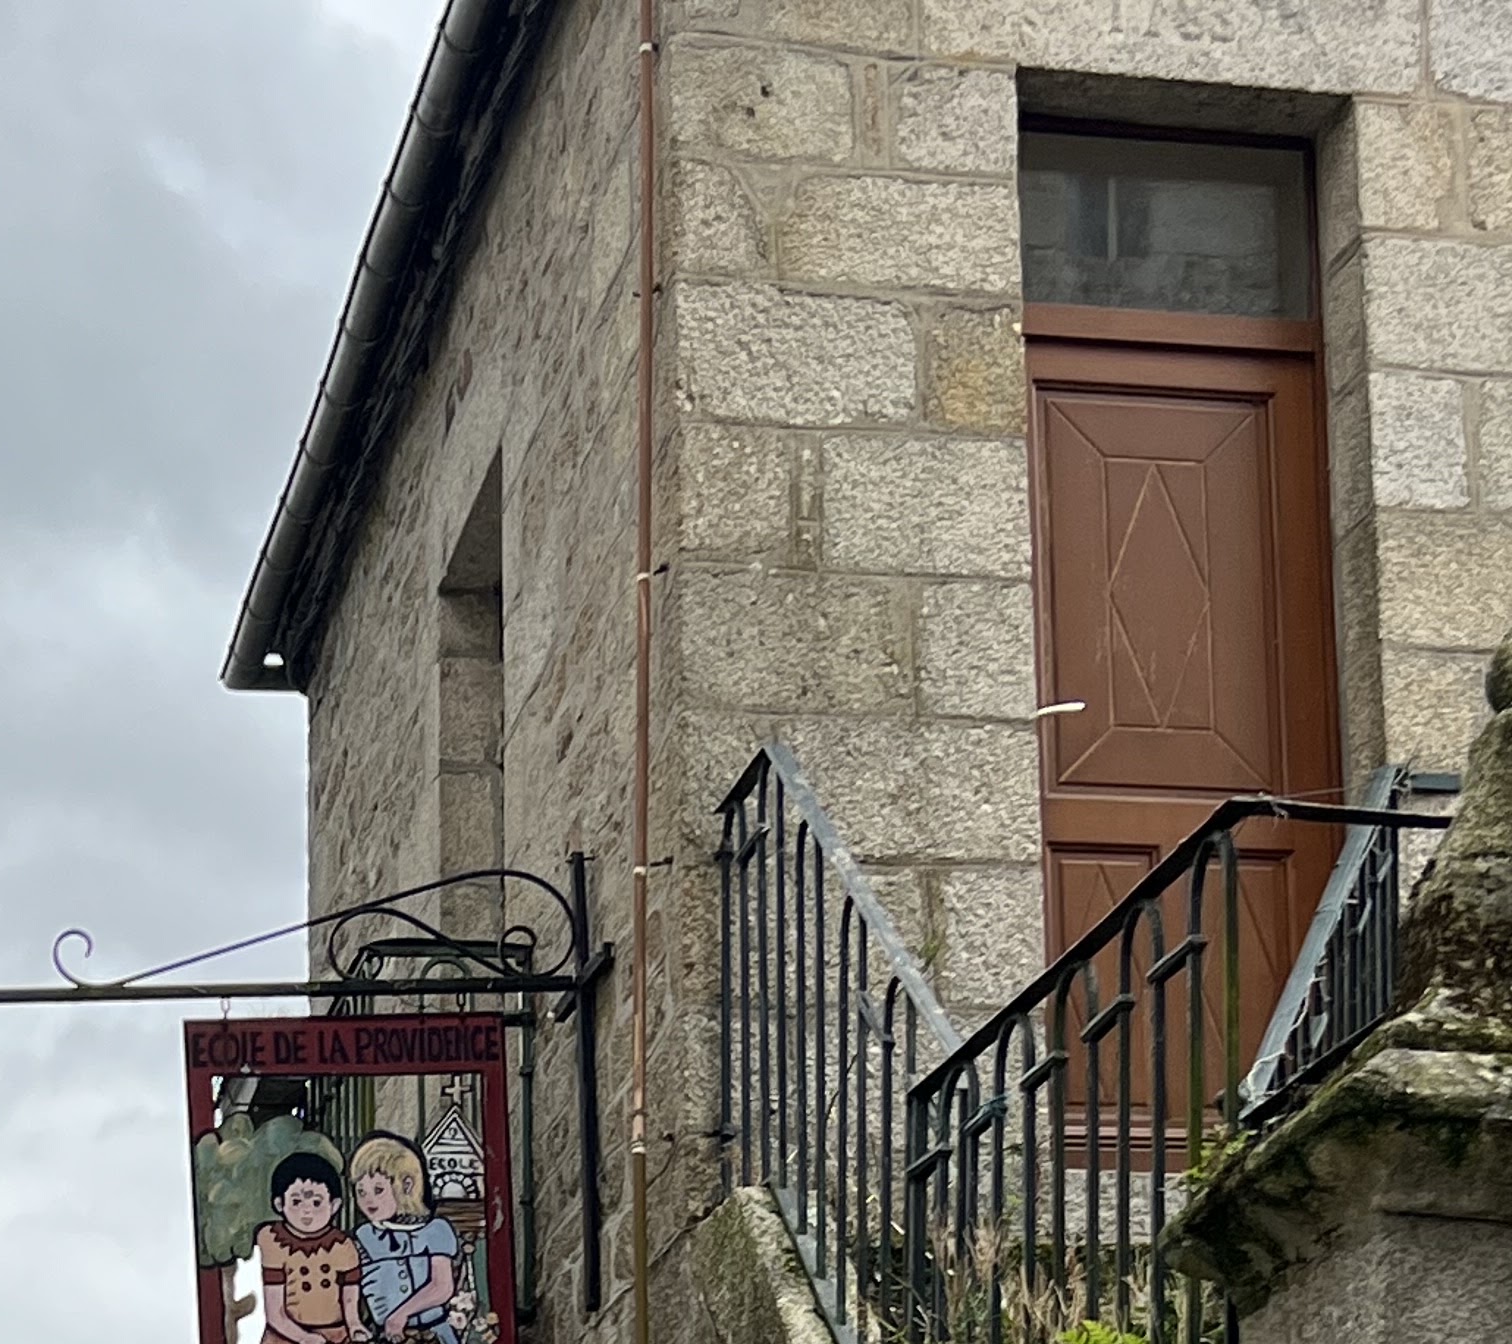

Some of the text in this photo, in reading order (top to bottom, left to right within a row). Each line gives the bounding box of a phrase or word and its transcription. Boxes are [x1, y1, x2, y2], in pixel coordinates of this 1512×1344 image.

[273, 1030, 308, 1065] DE
[319, 1028, 350, 1064] LA
[354, 1022, 499, 1064] PROVIDENCE
[429, 1156, 479, 1171] ECOLE
